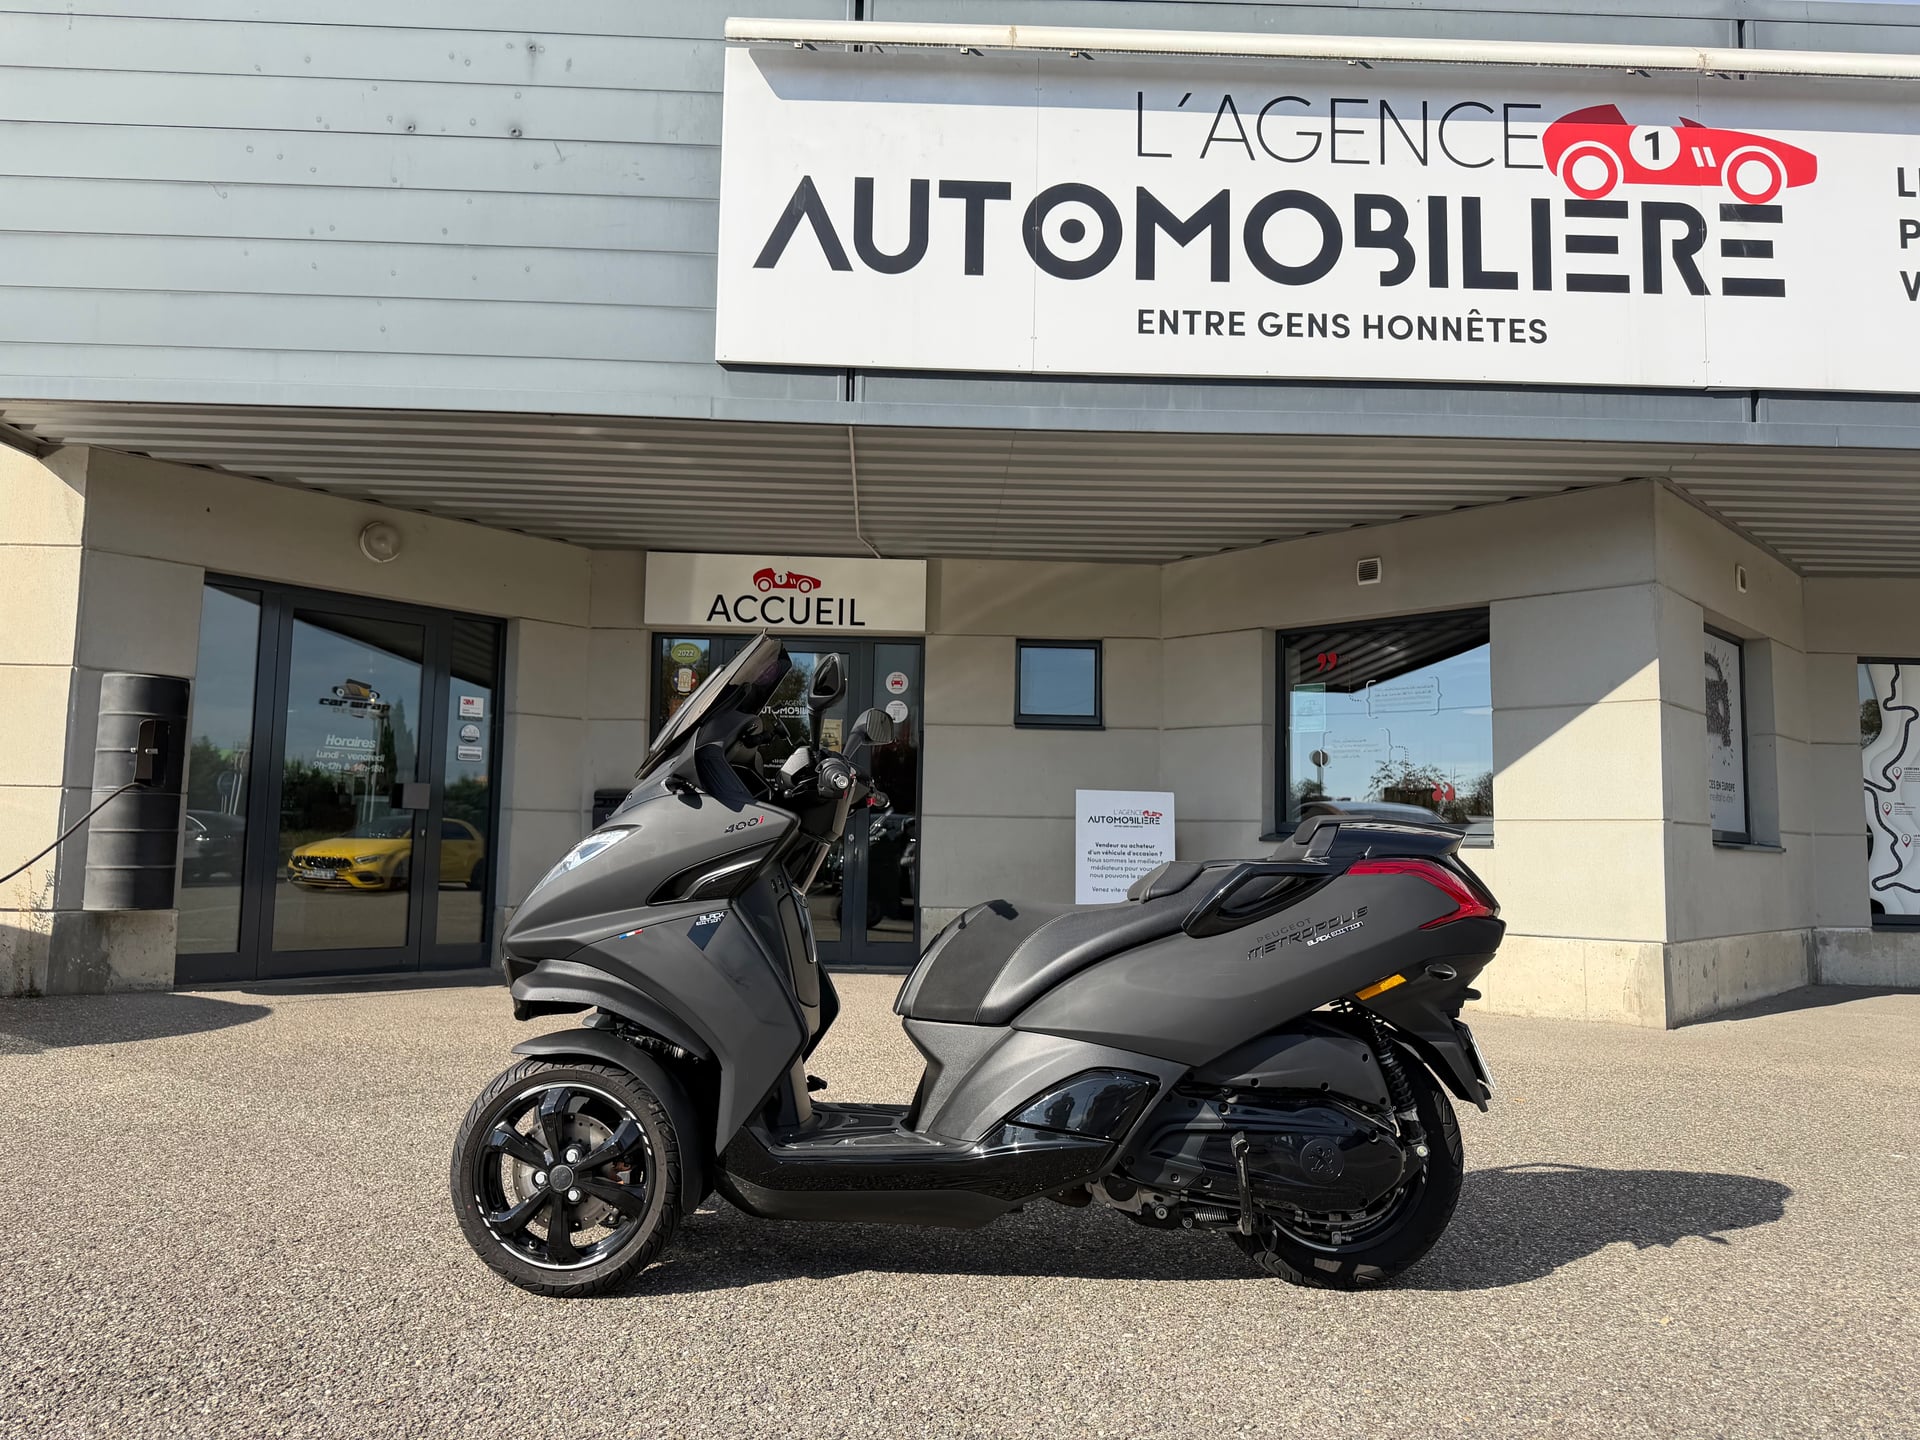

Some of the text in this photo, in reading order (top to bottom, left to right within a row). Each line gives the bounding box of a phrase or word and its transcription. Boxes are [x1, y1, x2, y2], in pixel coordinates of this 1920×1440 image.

[1137, 91, 1544, 169] L'AGENCE
[1644, 131, 1661, 161] 1
[1897, 167, 1920, 198] L
[1137, 308, 1548, 344] ENTRE GENS HONNÊTES
[707, 594, 866, 626] ACCUEIL
[678, 649, 695, 658] 2022
[325, 734, 377, 748] Horaires
[724, 815, 765, 833] 400i
[699, 911, 725, 921] BLACK
[1256, 917, 1312, 943] PEUGEOT
[1247, 905, 1369, 960] METROPOLIS
[1306, 933, 1331, 947] BLACK
